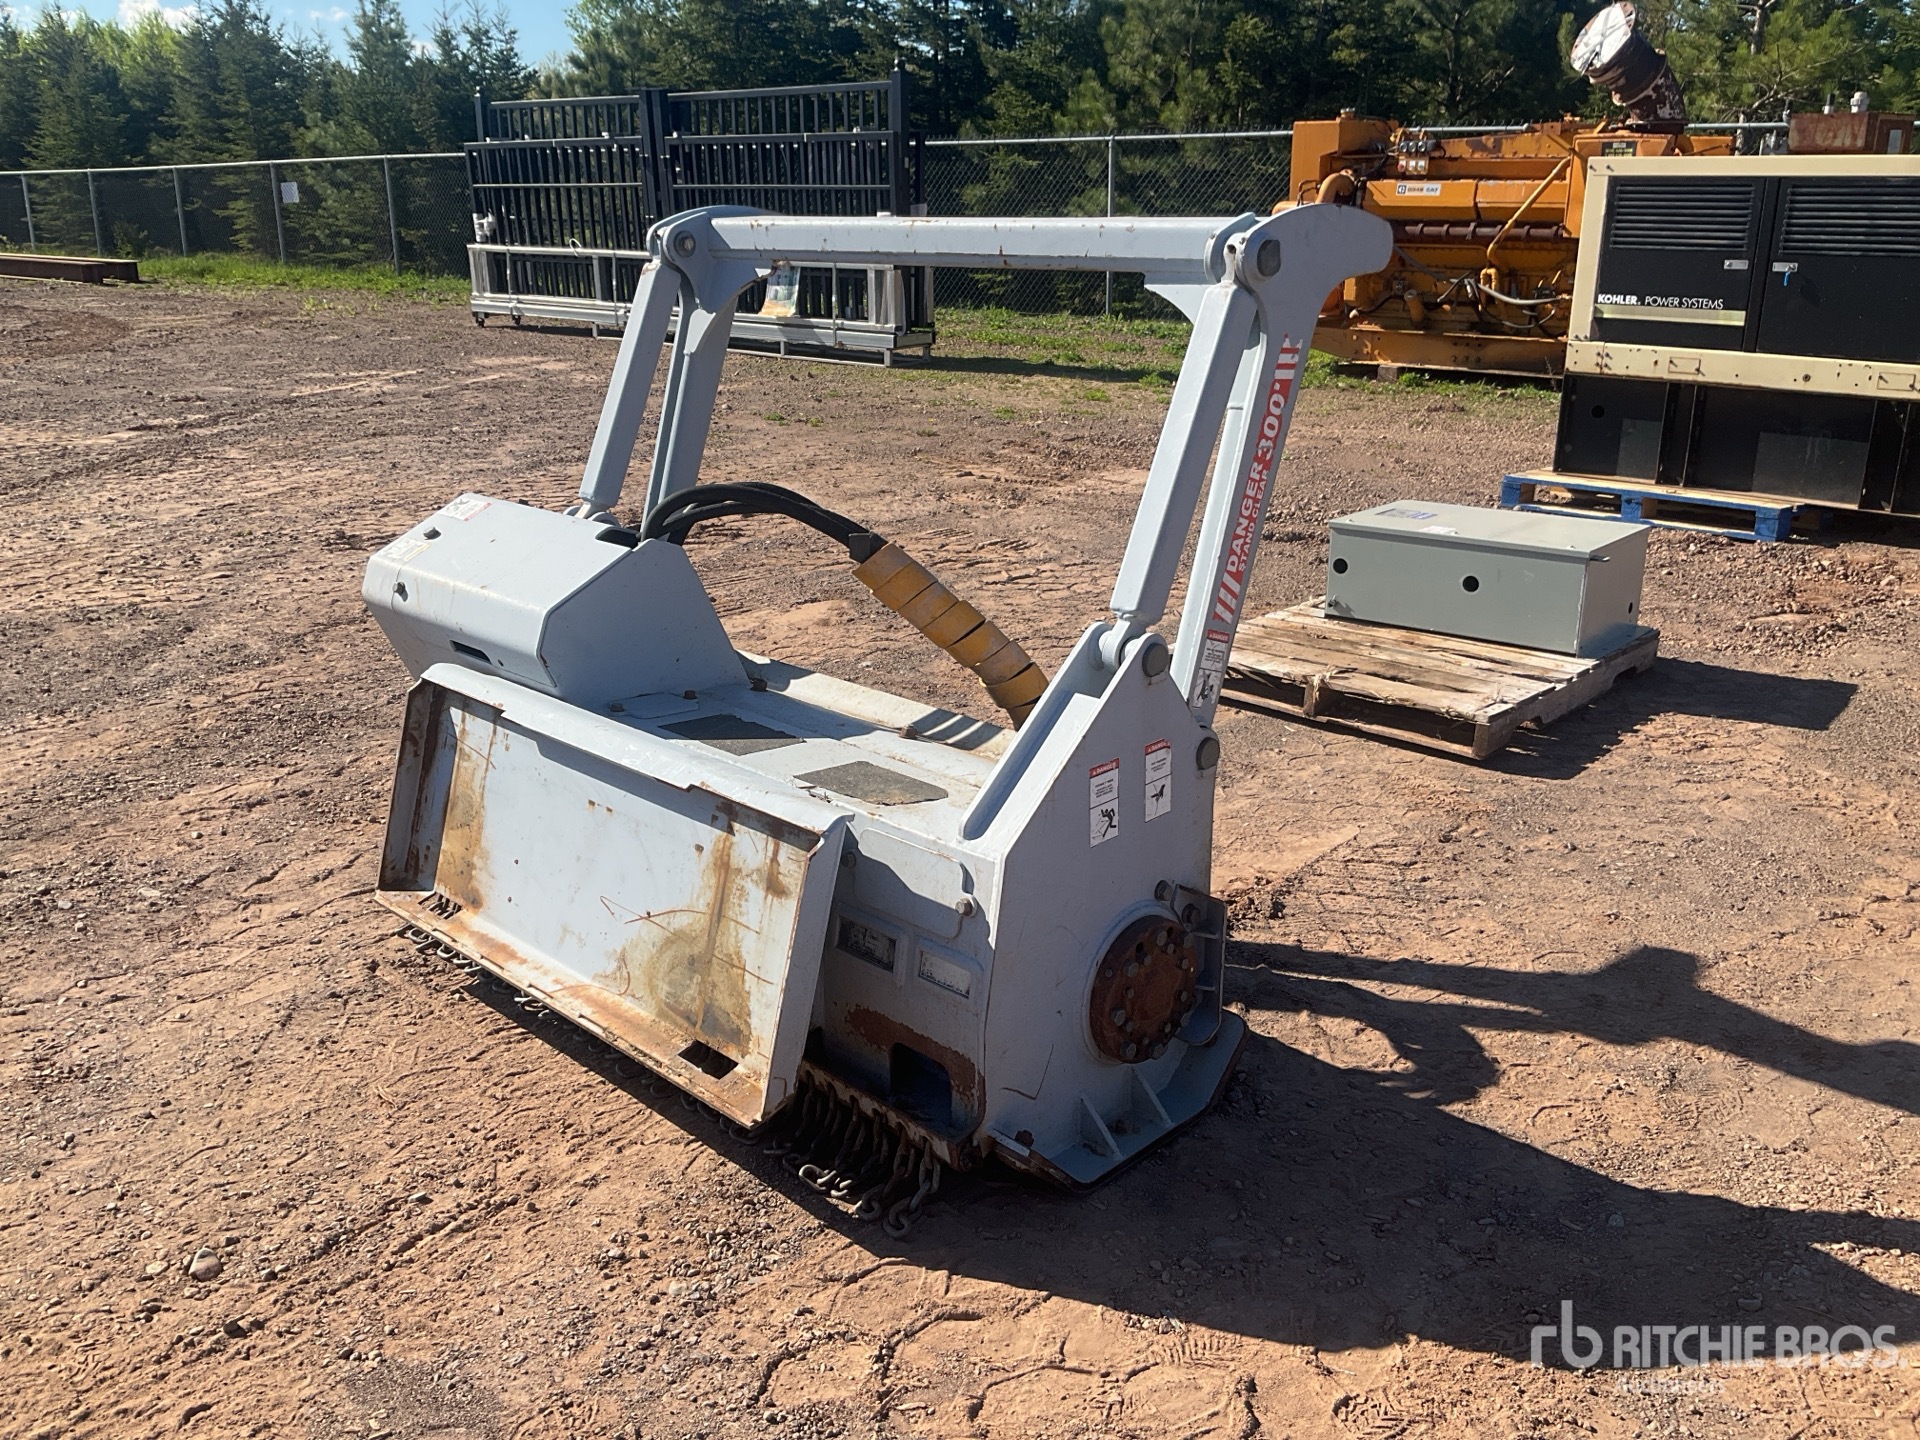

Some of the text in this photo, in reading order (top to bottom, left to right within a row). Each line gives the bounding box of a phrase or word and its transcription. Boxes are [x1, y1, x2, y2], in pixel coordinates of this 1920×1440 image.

[1644, 296, 1680, 308] POWER
[1681, 297, 1724, 310] SYSTEMS
[1227, 462, 1263, 573] DANGER
[1238, 469, 1269, 572] STAND CLEAR
